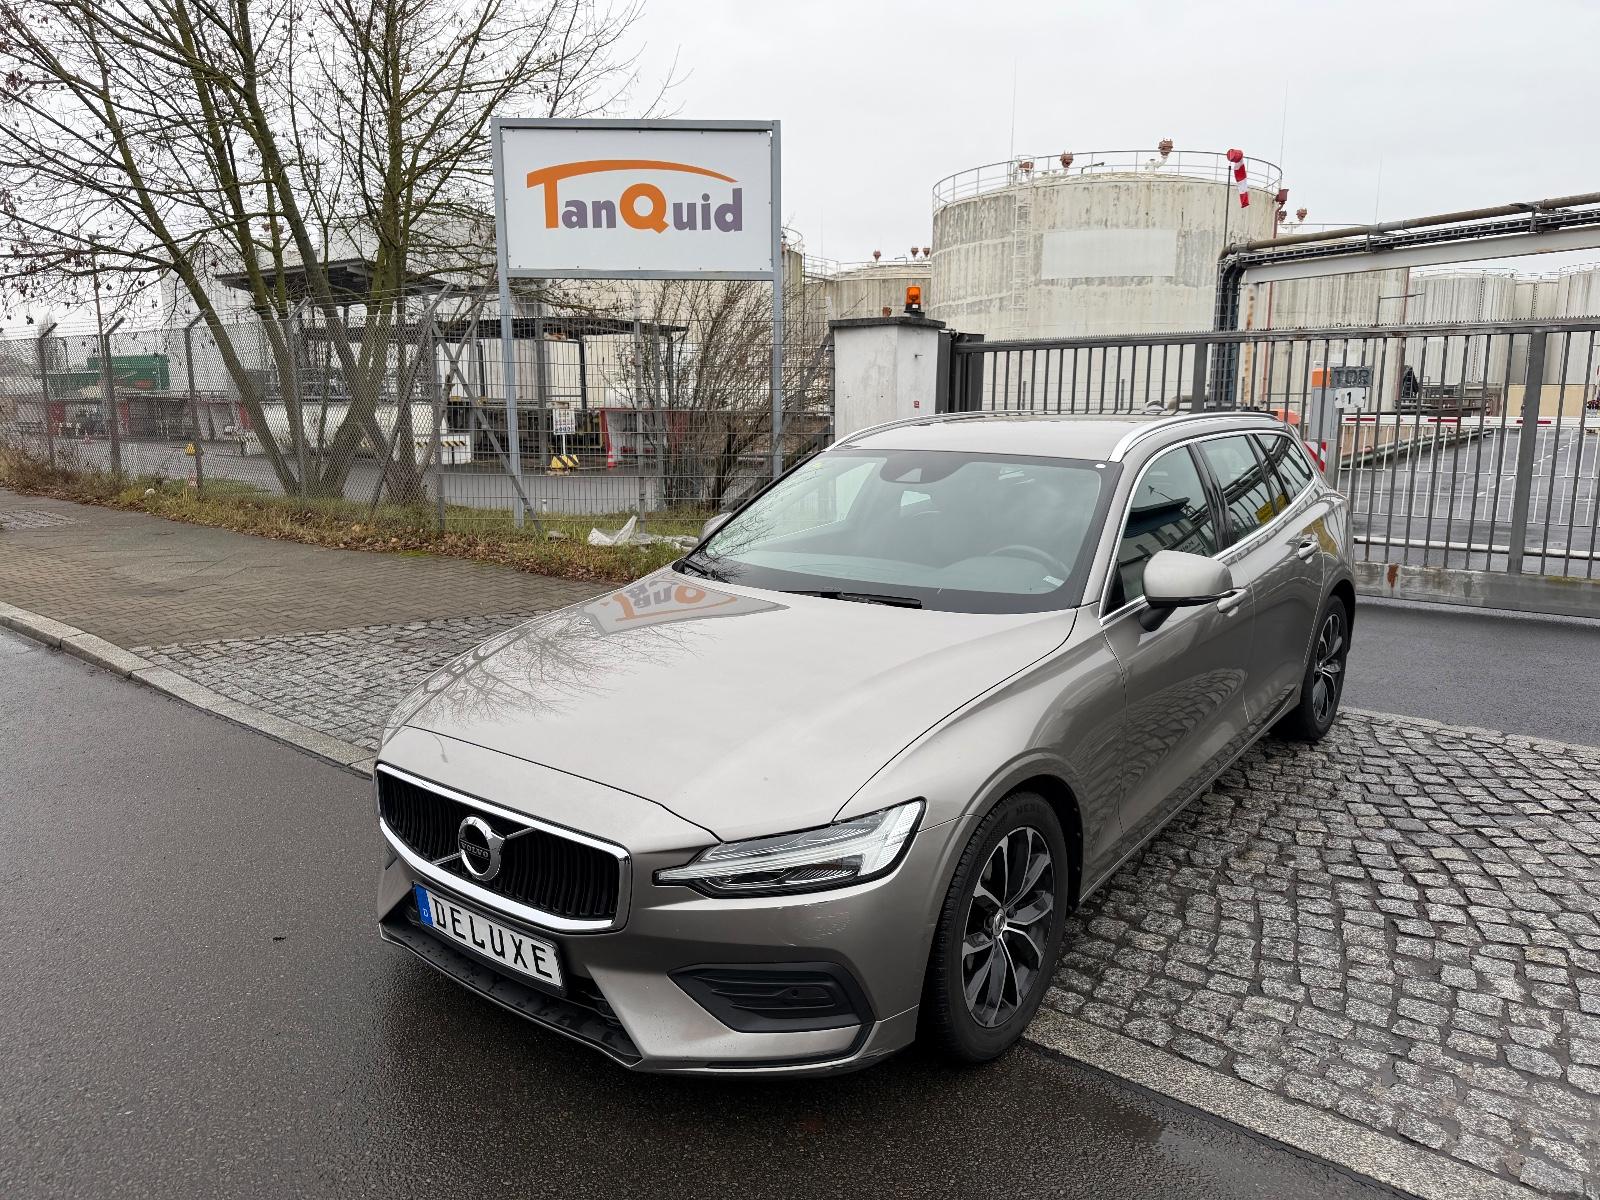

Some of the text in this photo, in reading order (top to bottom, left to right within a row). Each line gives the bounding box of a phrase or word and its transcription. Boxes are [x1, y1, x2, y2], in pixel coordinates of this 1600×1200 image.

[526, 159, 743, 234] TanQuid
[1334, 369, 1370, 385] TOR
[460, 841, 489, 858] VOLVO
[431, 896, 553, 979] DELUXE
